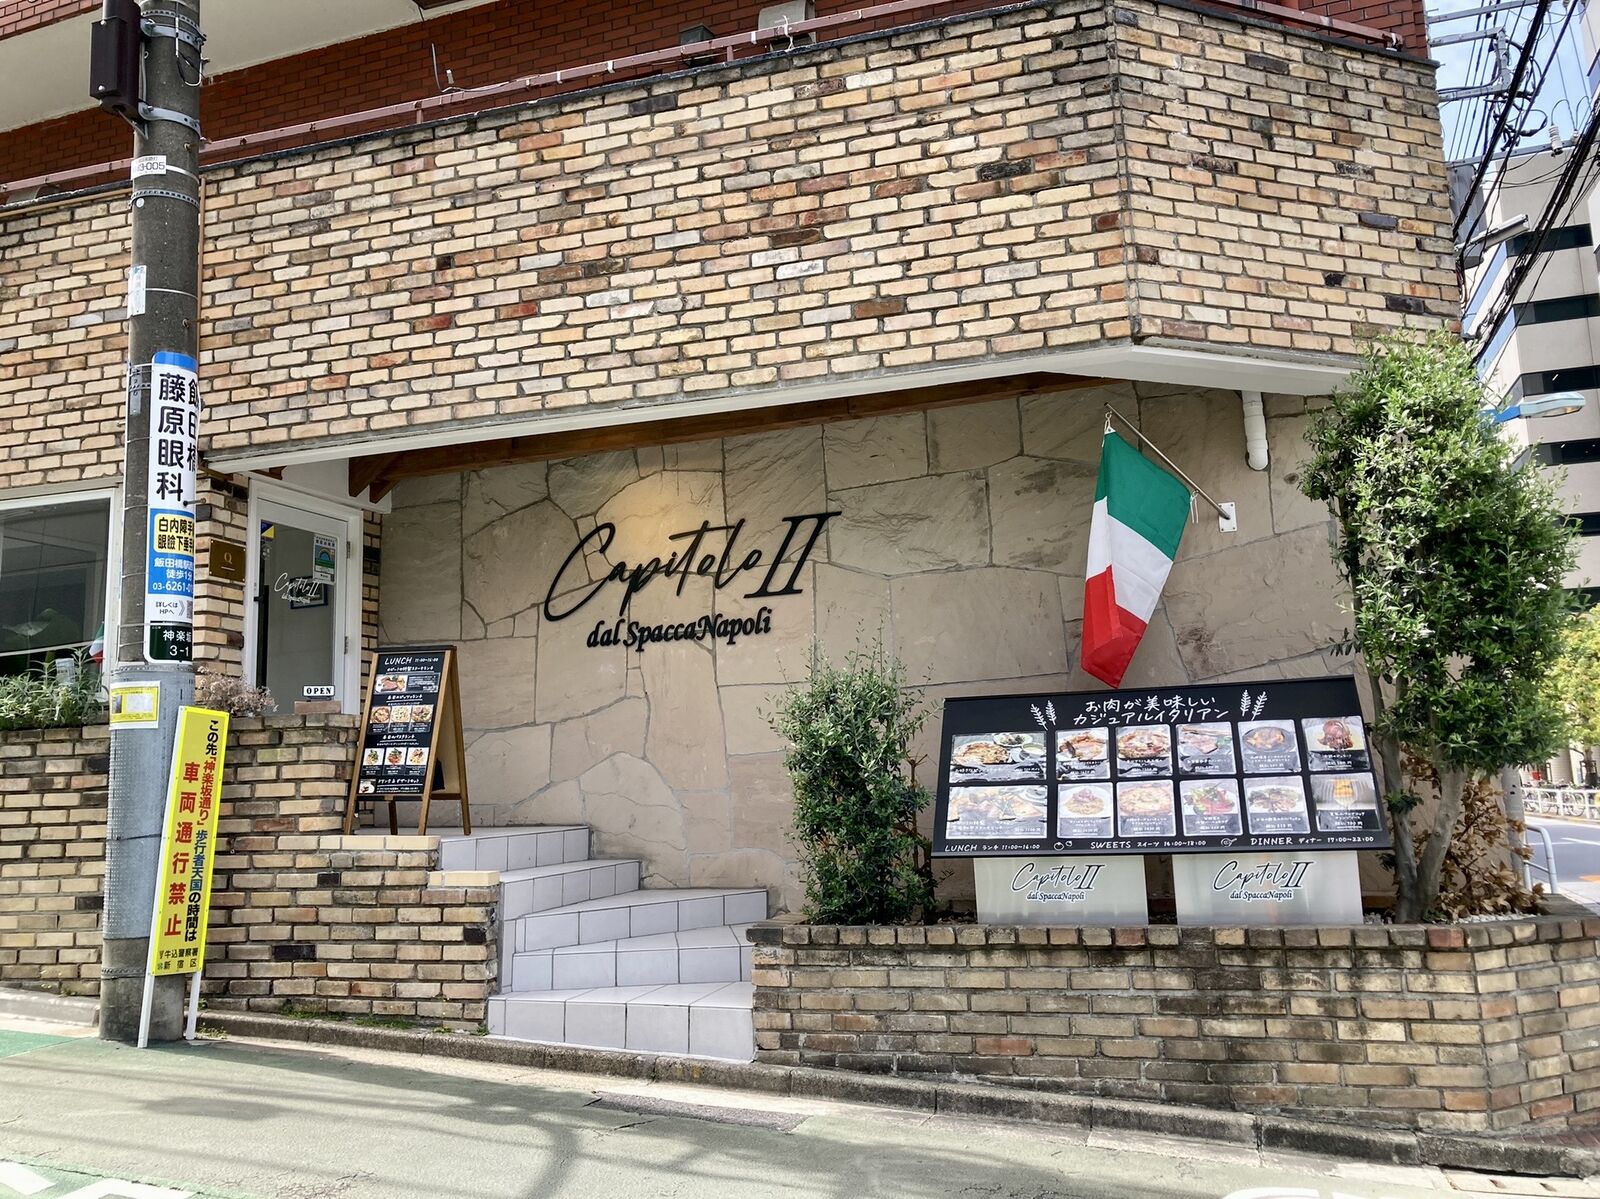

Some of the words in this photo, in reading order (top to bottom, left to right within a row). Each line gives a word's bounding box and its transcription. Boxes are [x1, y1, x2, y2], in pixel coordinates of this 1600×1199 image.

[156, 373, 186, 501] 藤原眼科
[544, 518, 762, 621] Capitolo
[586, 619, 627, 648] dal
[623, 607, 773, 652] SpaccaNapoli
[170, 645, 189, 658] 3-1
[384, 656, 413, 666] LUNCH
[306, 686, 332, 695] OPEN
[1086, 694, 1215, 712] お肉が美味しい
[1073, 709, 1229, 725] カジュアルイタリアン
[944, 844, 978, 852] LUNCH
[1090, 841, 1131, 849] SWEETS
[1250, 837, 1294, 846] DINNER
[165, 762, 200, 936] 車両通行禁止
[1012, 862, 1083, 891] Capitolo
[1213, 860, 1290, 891] Capitolo
[1027, 891, 1038, 900] dal
[1039, 891, 1085, 902] SpaccaNapoli
[1230, 890, 1242, 899] dal
[1243, 889, 1293, 901] SpaccaNapoli
[164, 958, 197, 970] 新宿区
